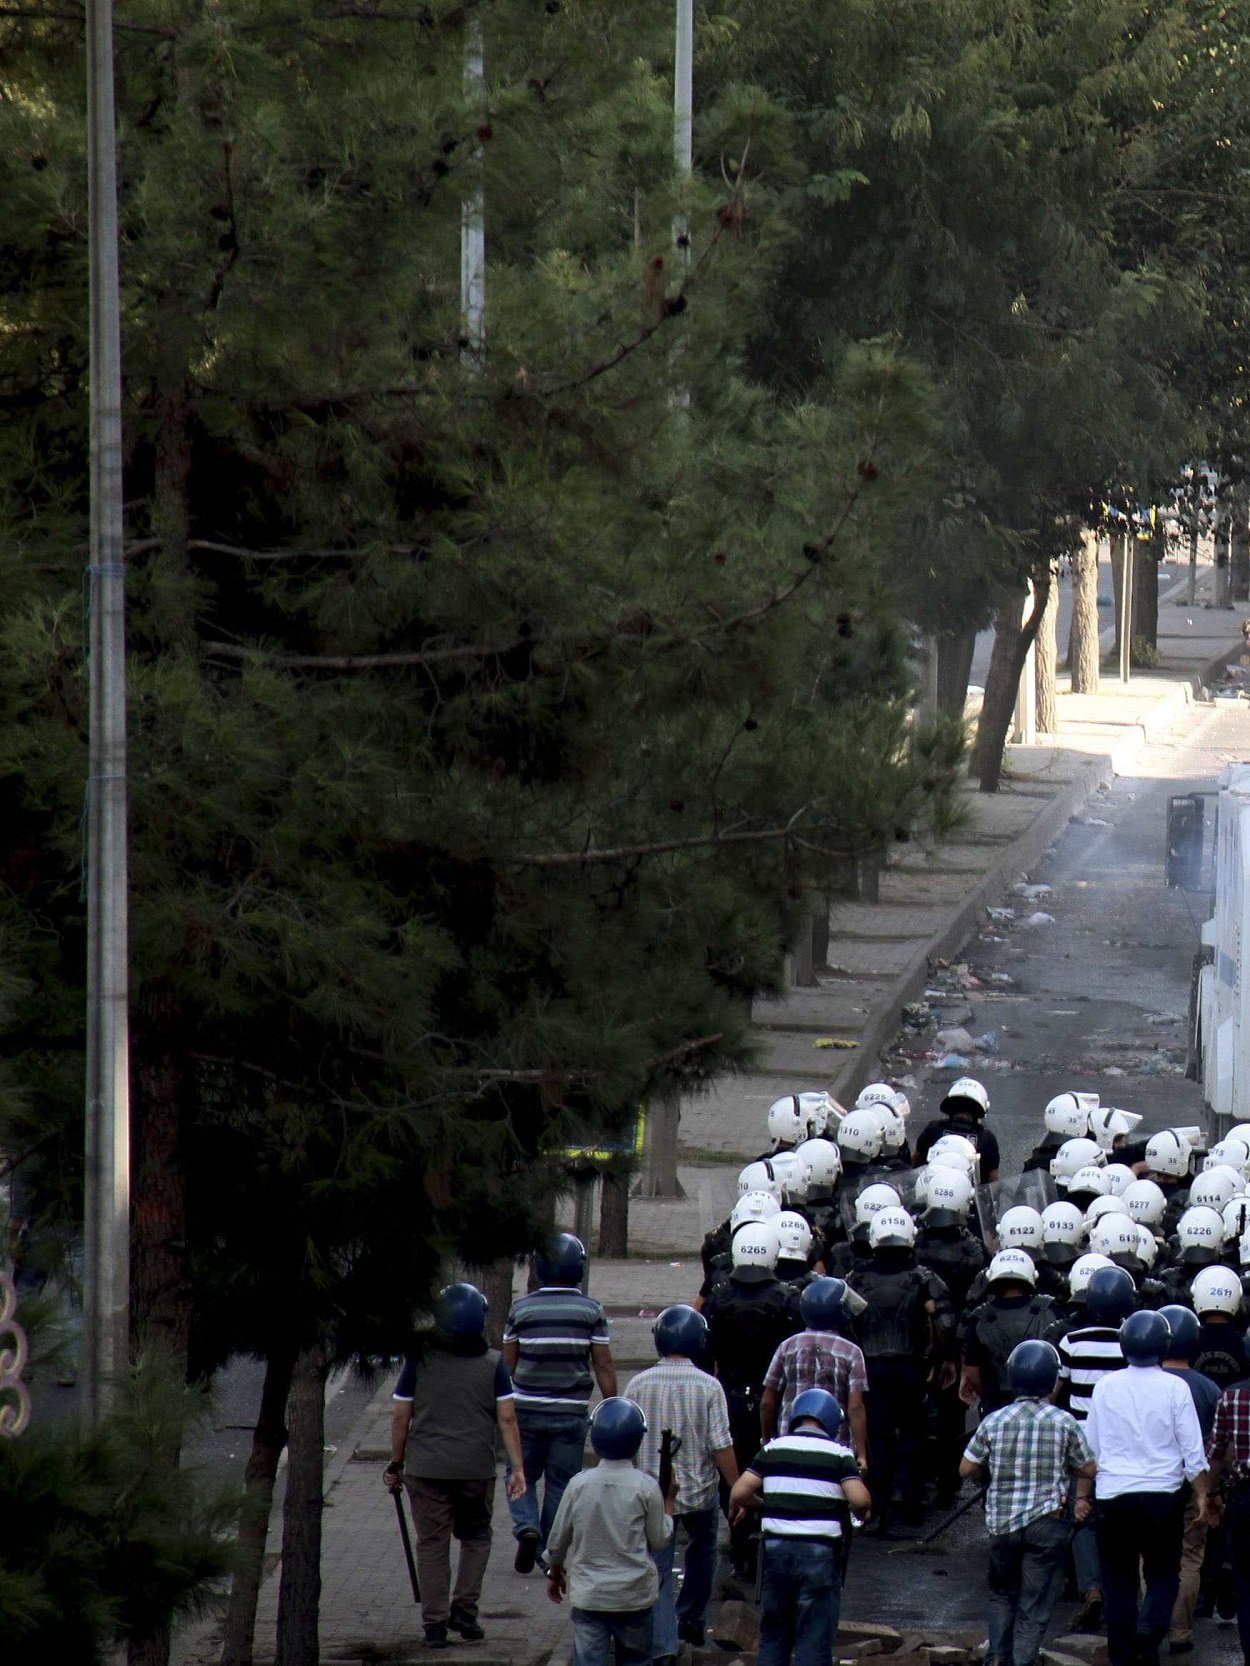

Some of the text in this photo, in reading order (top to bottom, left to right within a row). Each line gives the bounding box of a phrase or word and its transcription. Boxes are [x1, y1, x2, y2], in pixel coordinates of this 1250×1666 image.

[1197, 1194, 1221, 1203] 6114
[1129, 1200, 1150, 1209] 6277
[780, 1220, 806, 1231] 6269
[1009, 1226, 1035, 1235] 6122
[1049, 1221, 1074, 1231] 6133
[1187, 1226, 1212, 1236] 6226
[740, 1245, 767, 1255] 6265
